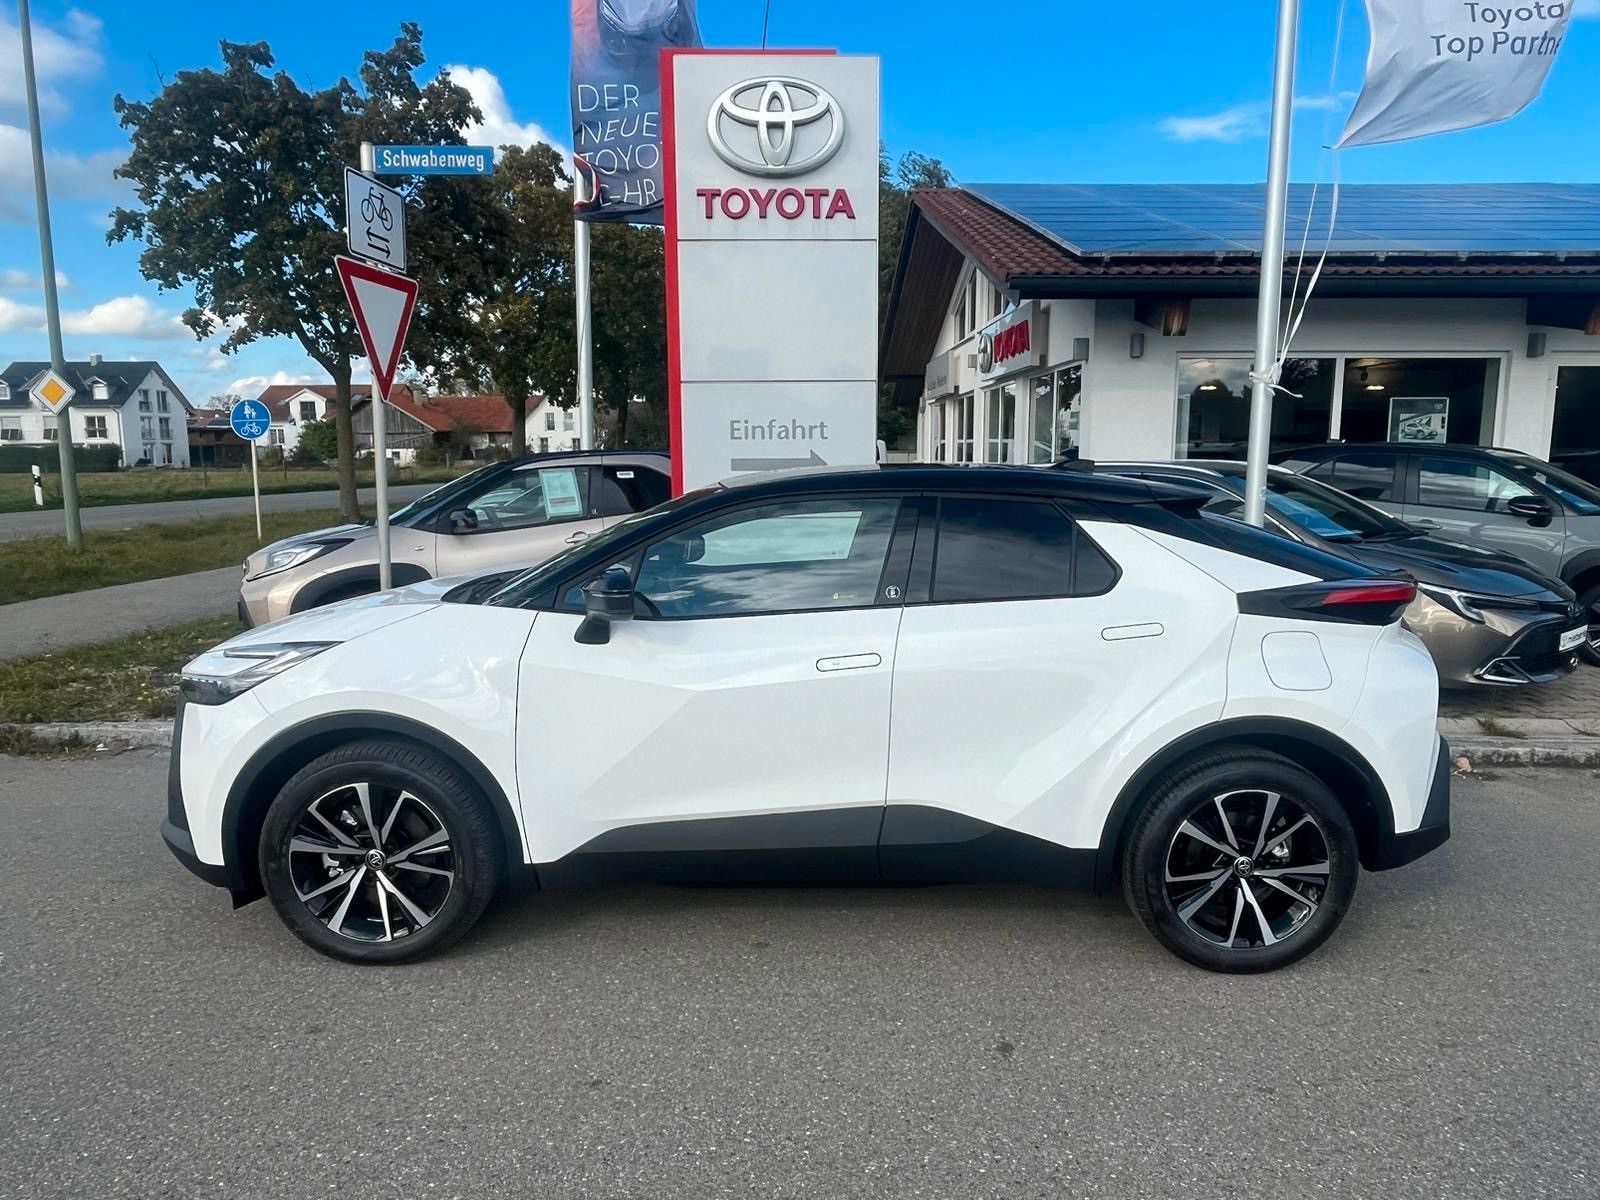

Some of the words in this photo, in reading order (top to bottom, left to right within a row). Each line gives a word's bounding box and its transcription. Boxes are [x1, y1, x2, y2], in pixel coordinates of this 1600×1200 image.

[1464, 1, 1564, 29] Toyota
[1430, 30, 1484, 62] Top
[577, 84, 640, 112] DER
[580, 111, 659, 145] NEUE
[383, 149, 485, 171] Schwabenweg
[579, 142, 662, 175] TOYO
[696, 187, 856, 220] TOYOTA
[729, 418, 829, 440] Einfahrt
